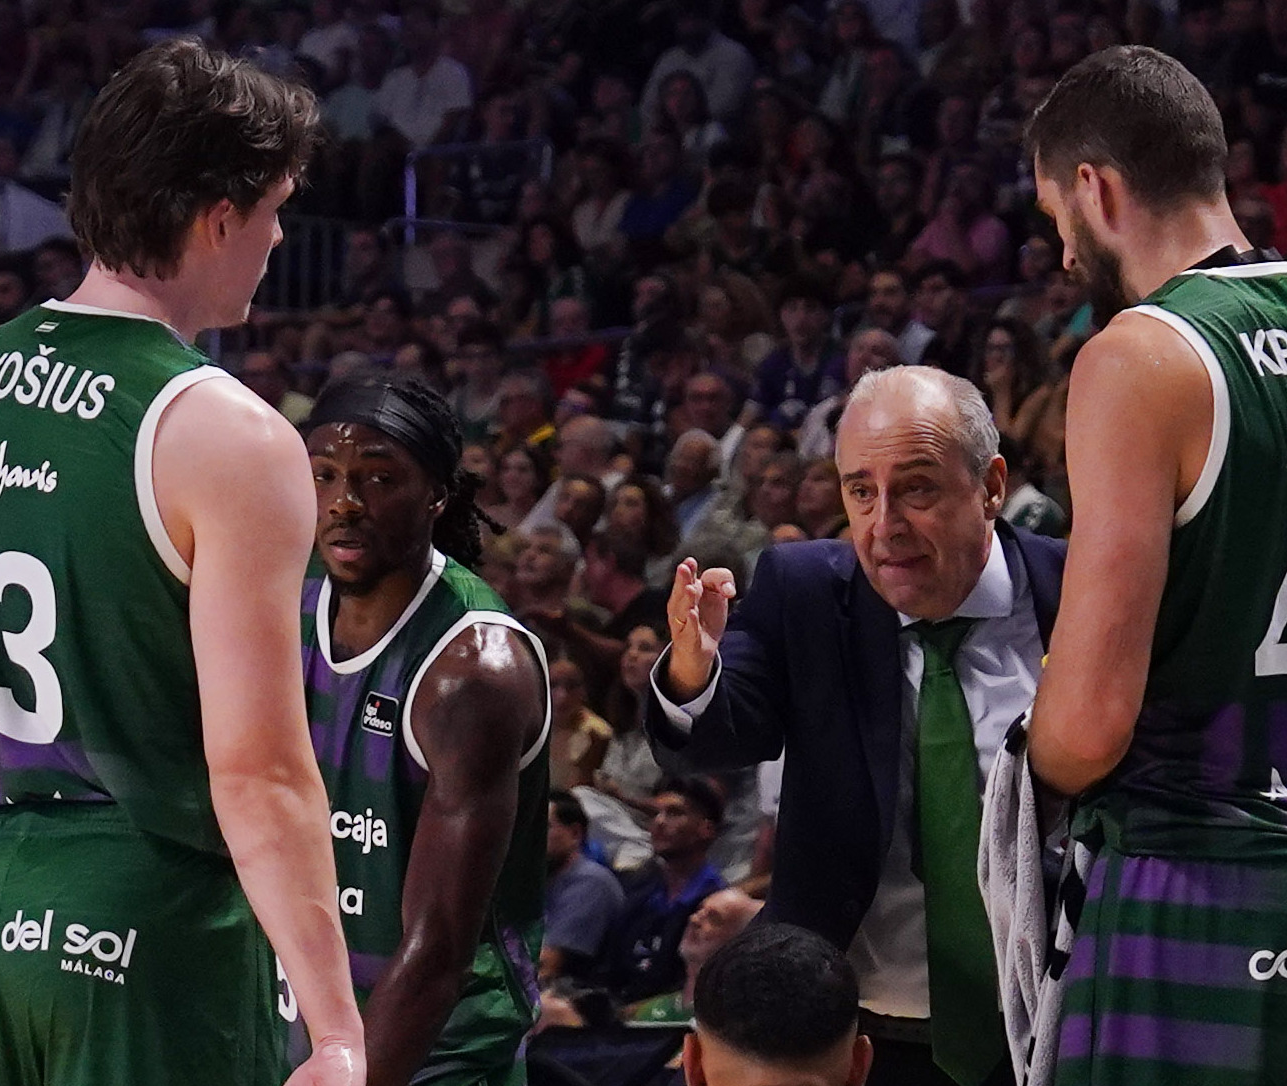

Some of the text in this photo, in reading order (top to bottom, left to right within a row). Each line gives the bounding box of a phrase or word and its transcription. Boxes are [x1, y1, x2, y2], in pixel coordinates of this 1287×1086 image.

[328, 807, 388, 854] caja
[1, 909, 55, 952] del
[63, 923, 138, 969] sol
[60, 959, 126, 986] MÁLAGA
